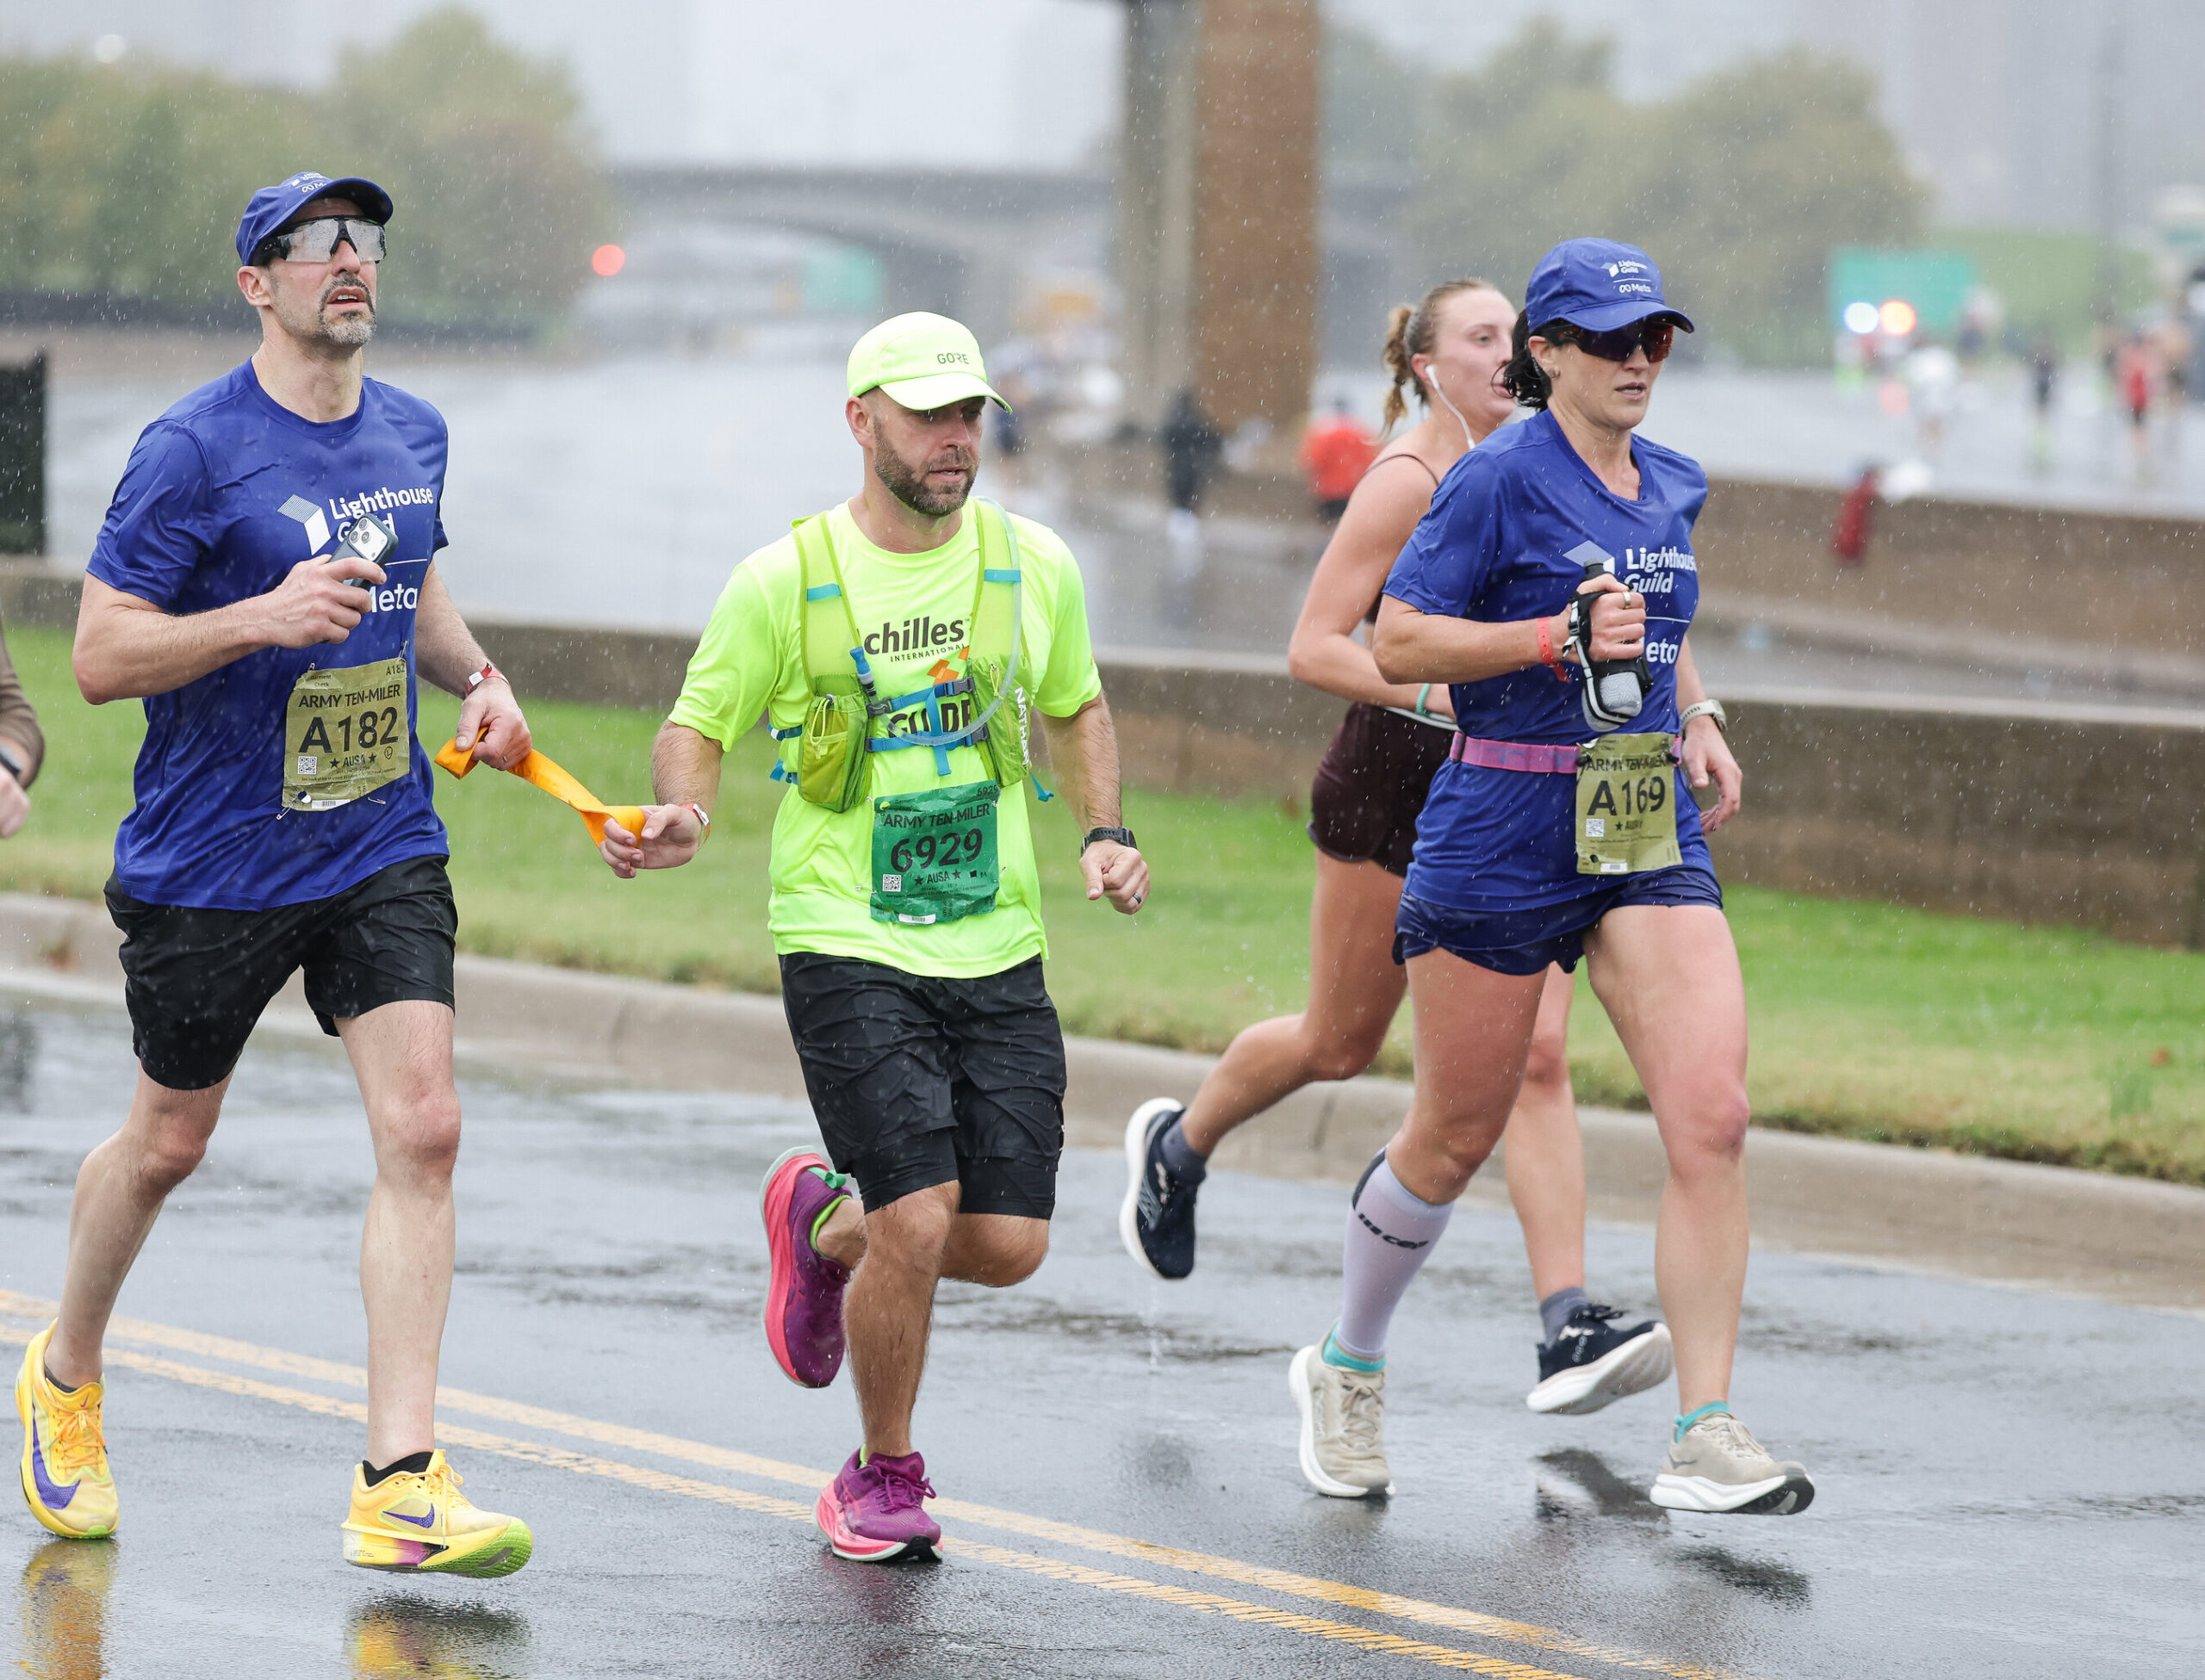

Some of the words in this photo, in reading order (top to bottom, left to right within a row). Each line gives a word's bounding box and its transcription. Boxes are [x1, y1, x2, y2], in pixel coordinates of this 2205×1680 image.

[936, 352, 970, 365] GORE
[329, 487, 434, 520] Lighthouse
[1624, 572, 1674, 594] Guild
[863, 616, 965, 655] chilles
[890, 643, 966, 662] INTERNATIONAL
[1640, 638, 1679, 664] eta
[386, 663, 406, 676] A182
[298, 695, 342, 708] ARMY
[345, 684, 401, 707] TEN-MILER
[297, 706, 400, 753] A182
[1014, 686, 1030, 766] NATHAN
[344, 754, 366, 767] AUSA
[1587, 758, 1623, 772] ARMY
[1587, 776, 1666, 815] A169
[884, 814, 925, 828] ARMY
[929, 803, 991, 827] TEN-MILER
[891, 828, 984, 873] 6929
[926, 871, 950, 884] AUSA
